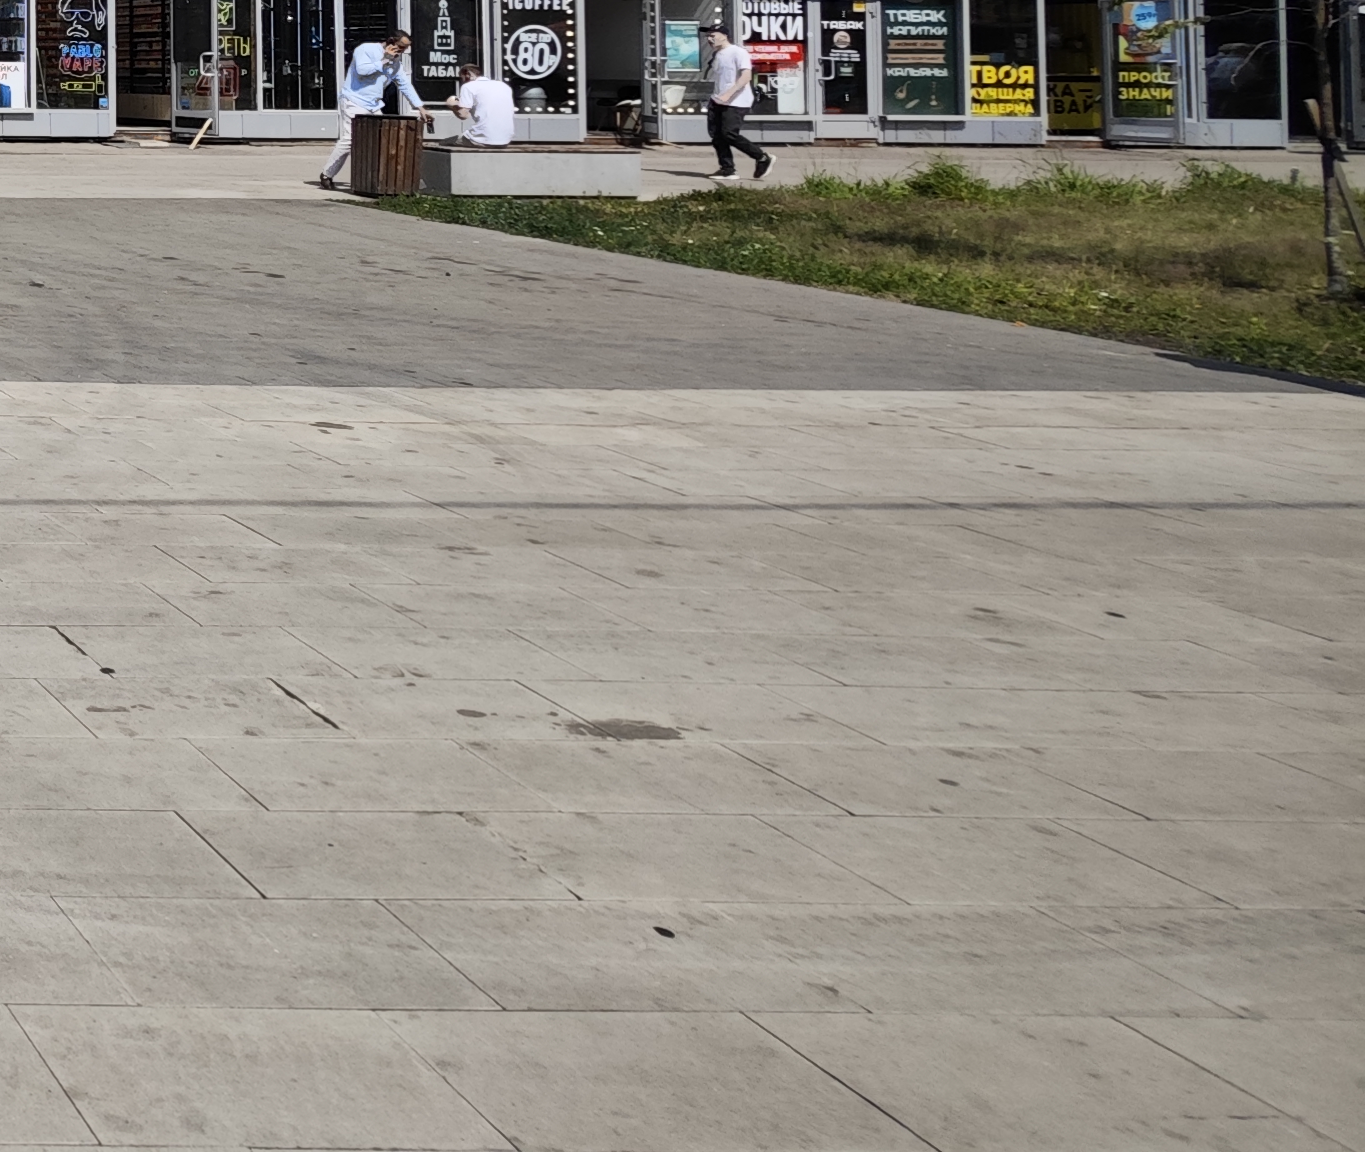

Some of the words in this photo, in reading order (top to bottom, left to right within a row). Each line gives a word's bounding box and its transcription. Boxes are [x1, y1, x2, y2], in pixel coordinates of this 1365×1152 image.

[742, 0, 804, 15] ОТОВЫЕ
[885, 9, 947, 22] ТАБАК
[821, 20, 865, 30] ТАБАК
[886, 26, 948, 36] НАПИТКИ
[429, 51, 458, 63] Мос
[62, 57, 102, 72] VAPE
[885, 67, 949, 77] КАЛЬЯНЫ
[970, 65, 1035, 84] ТВОЯ
[1118, 71, 1171, 83] ПРОСТ
[1118, 87, 1173, 100] ЗНАЧИ
